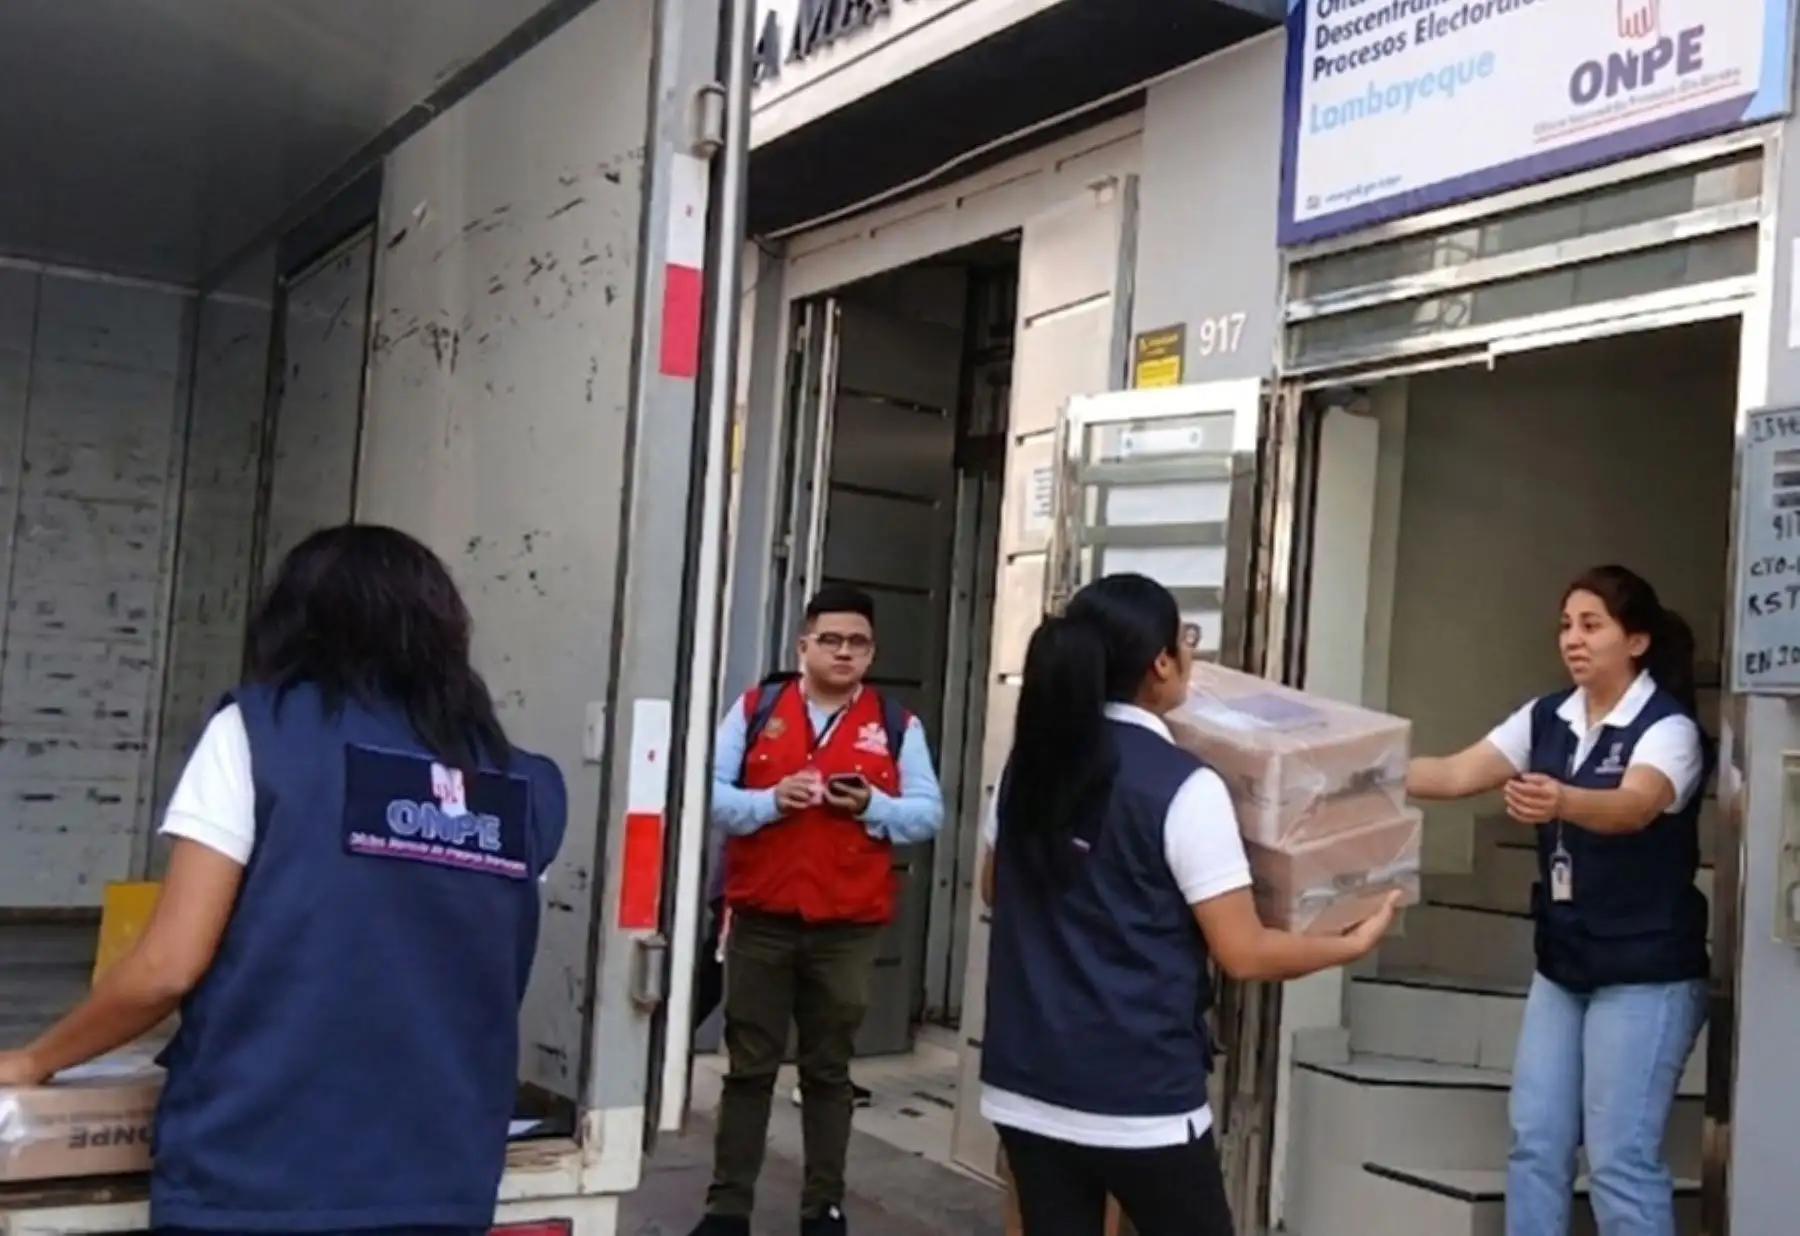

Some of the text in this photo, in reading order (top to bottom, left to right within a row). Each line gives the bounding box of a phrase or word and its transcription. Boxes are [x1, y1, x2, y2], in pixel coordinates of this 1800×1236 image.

[1313, 31, 1407, 81] Procesos
[1569, 24, 1705, 106] ONPE
[1310, 50, 1496, 135] Lambayeque
[1200, 313, 1246, 356] 917
[386, 799, 501, 851] ONPE
